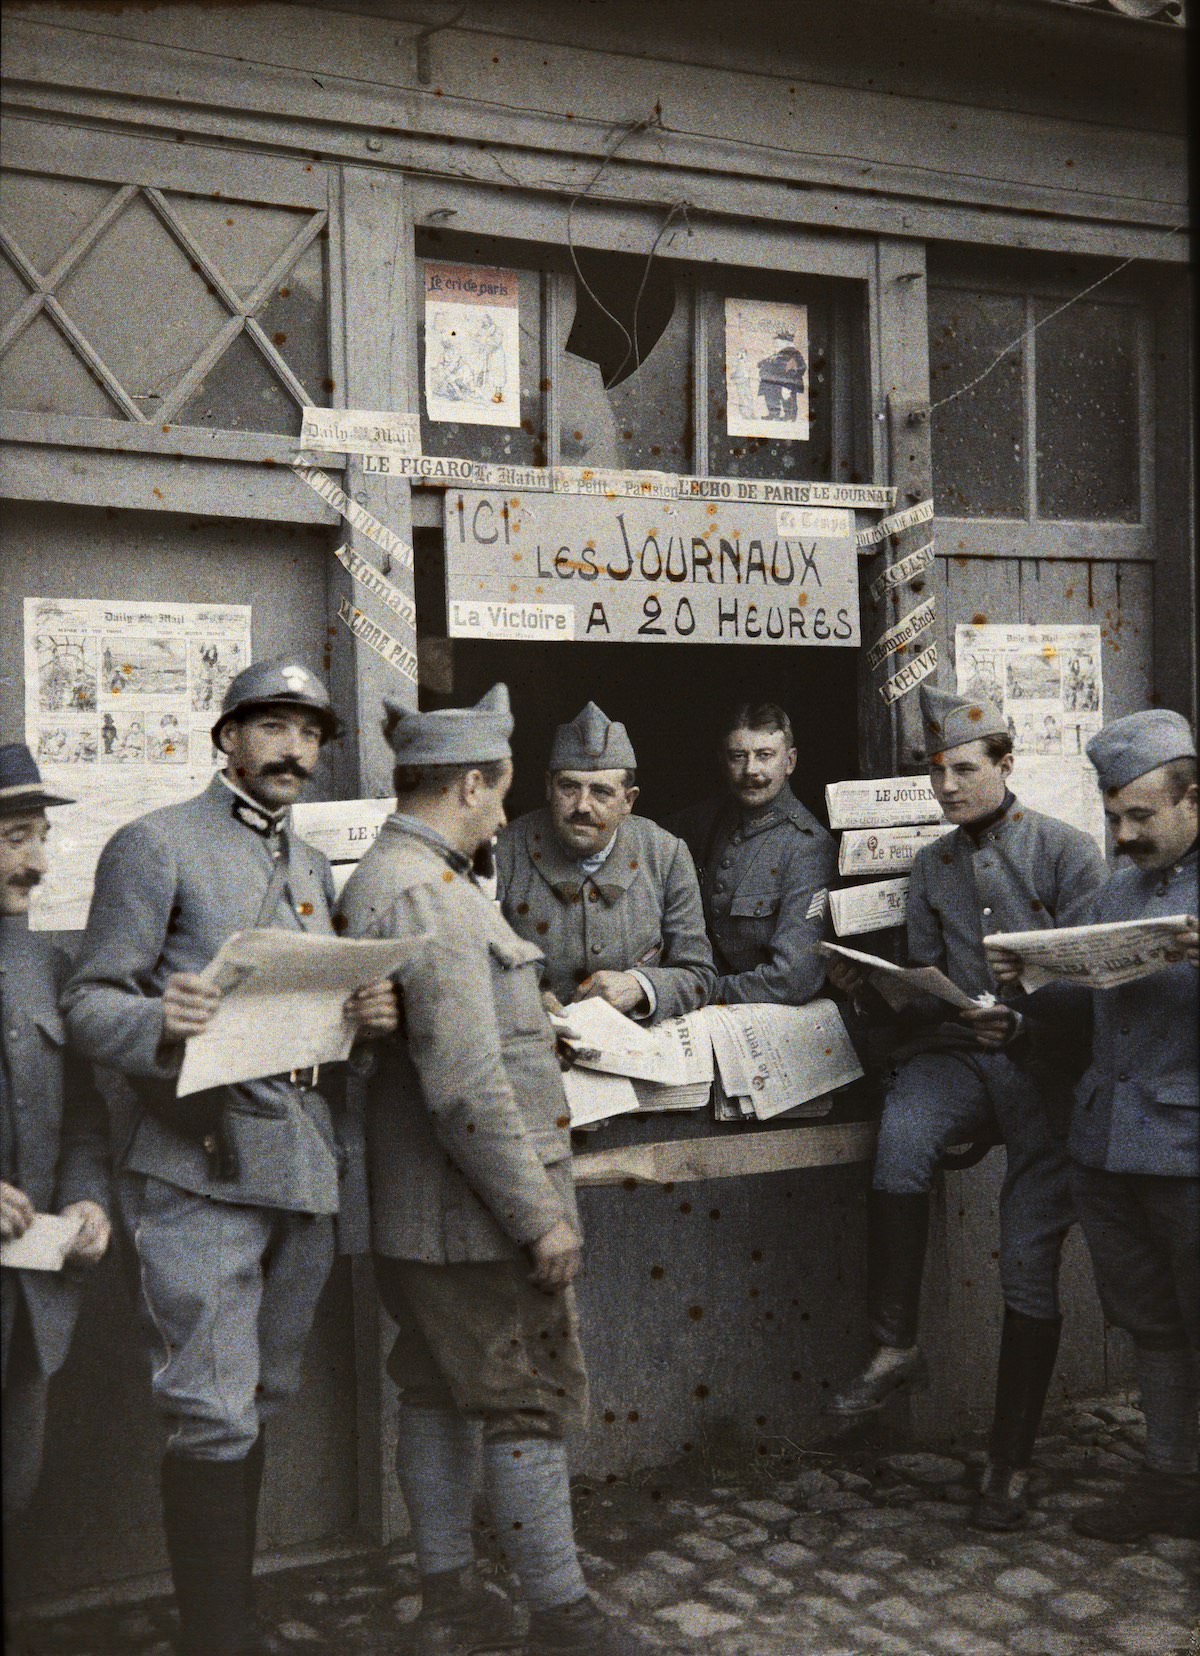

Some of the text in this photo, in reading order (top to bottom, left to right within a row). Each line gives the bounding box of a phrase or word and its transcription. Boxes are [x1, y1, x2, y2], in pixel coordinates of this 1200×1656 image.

[445, 276, 461, 291] cri
[463, 279, 477, 292] de
[477, 283, 508, 296] paris
[304, 422, 412, 443] Daily Mail
[365, 456, 472, 479] LE FIGARO
[498, 467, 545, 487] Matin
[554, 479, 678, 498] Le Petit Parisien
[678, 479, 810, 502] L'ECHO DE PARIS
[813, 487, 891, 502] LE JOURNAL
[458, 494, 511, 545] ICI
[104, 611, 132, 624] Daily
[158, 613, 184, 625] Mail
[454, 605, 567, 629] La Victoire
[586, 602, 610, 634] A
[638, 595, 696, 636] 20
[876, 790, 891, 802] LE
[348, 827, 367, 841] LE
[871, 844, 913, 860] Le Petit
[674, 1016, 693, 1058] ARIS
